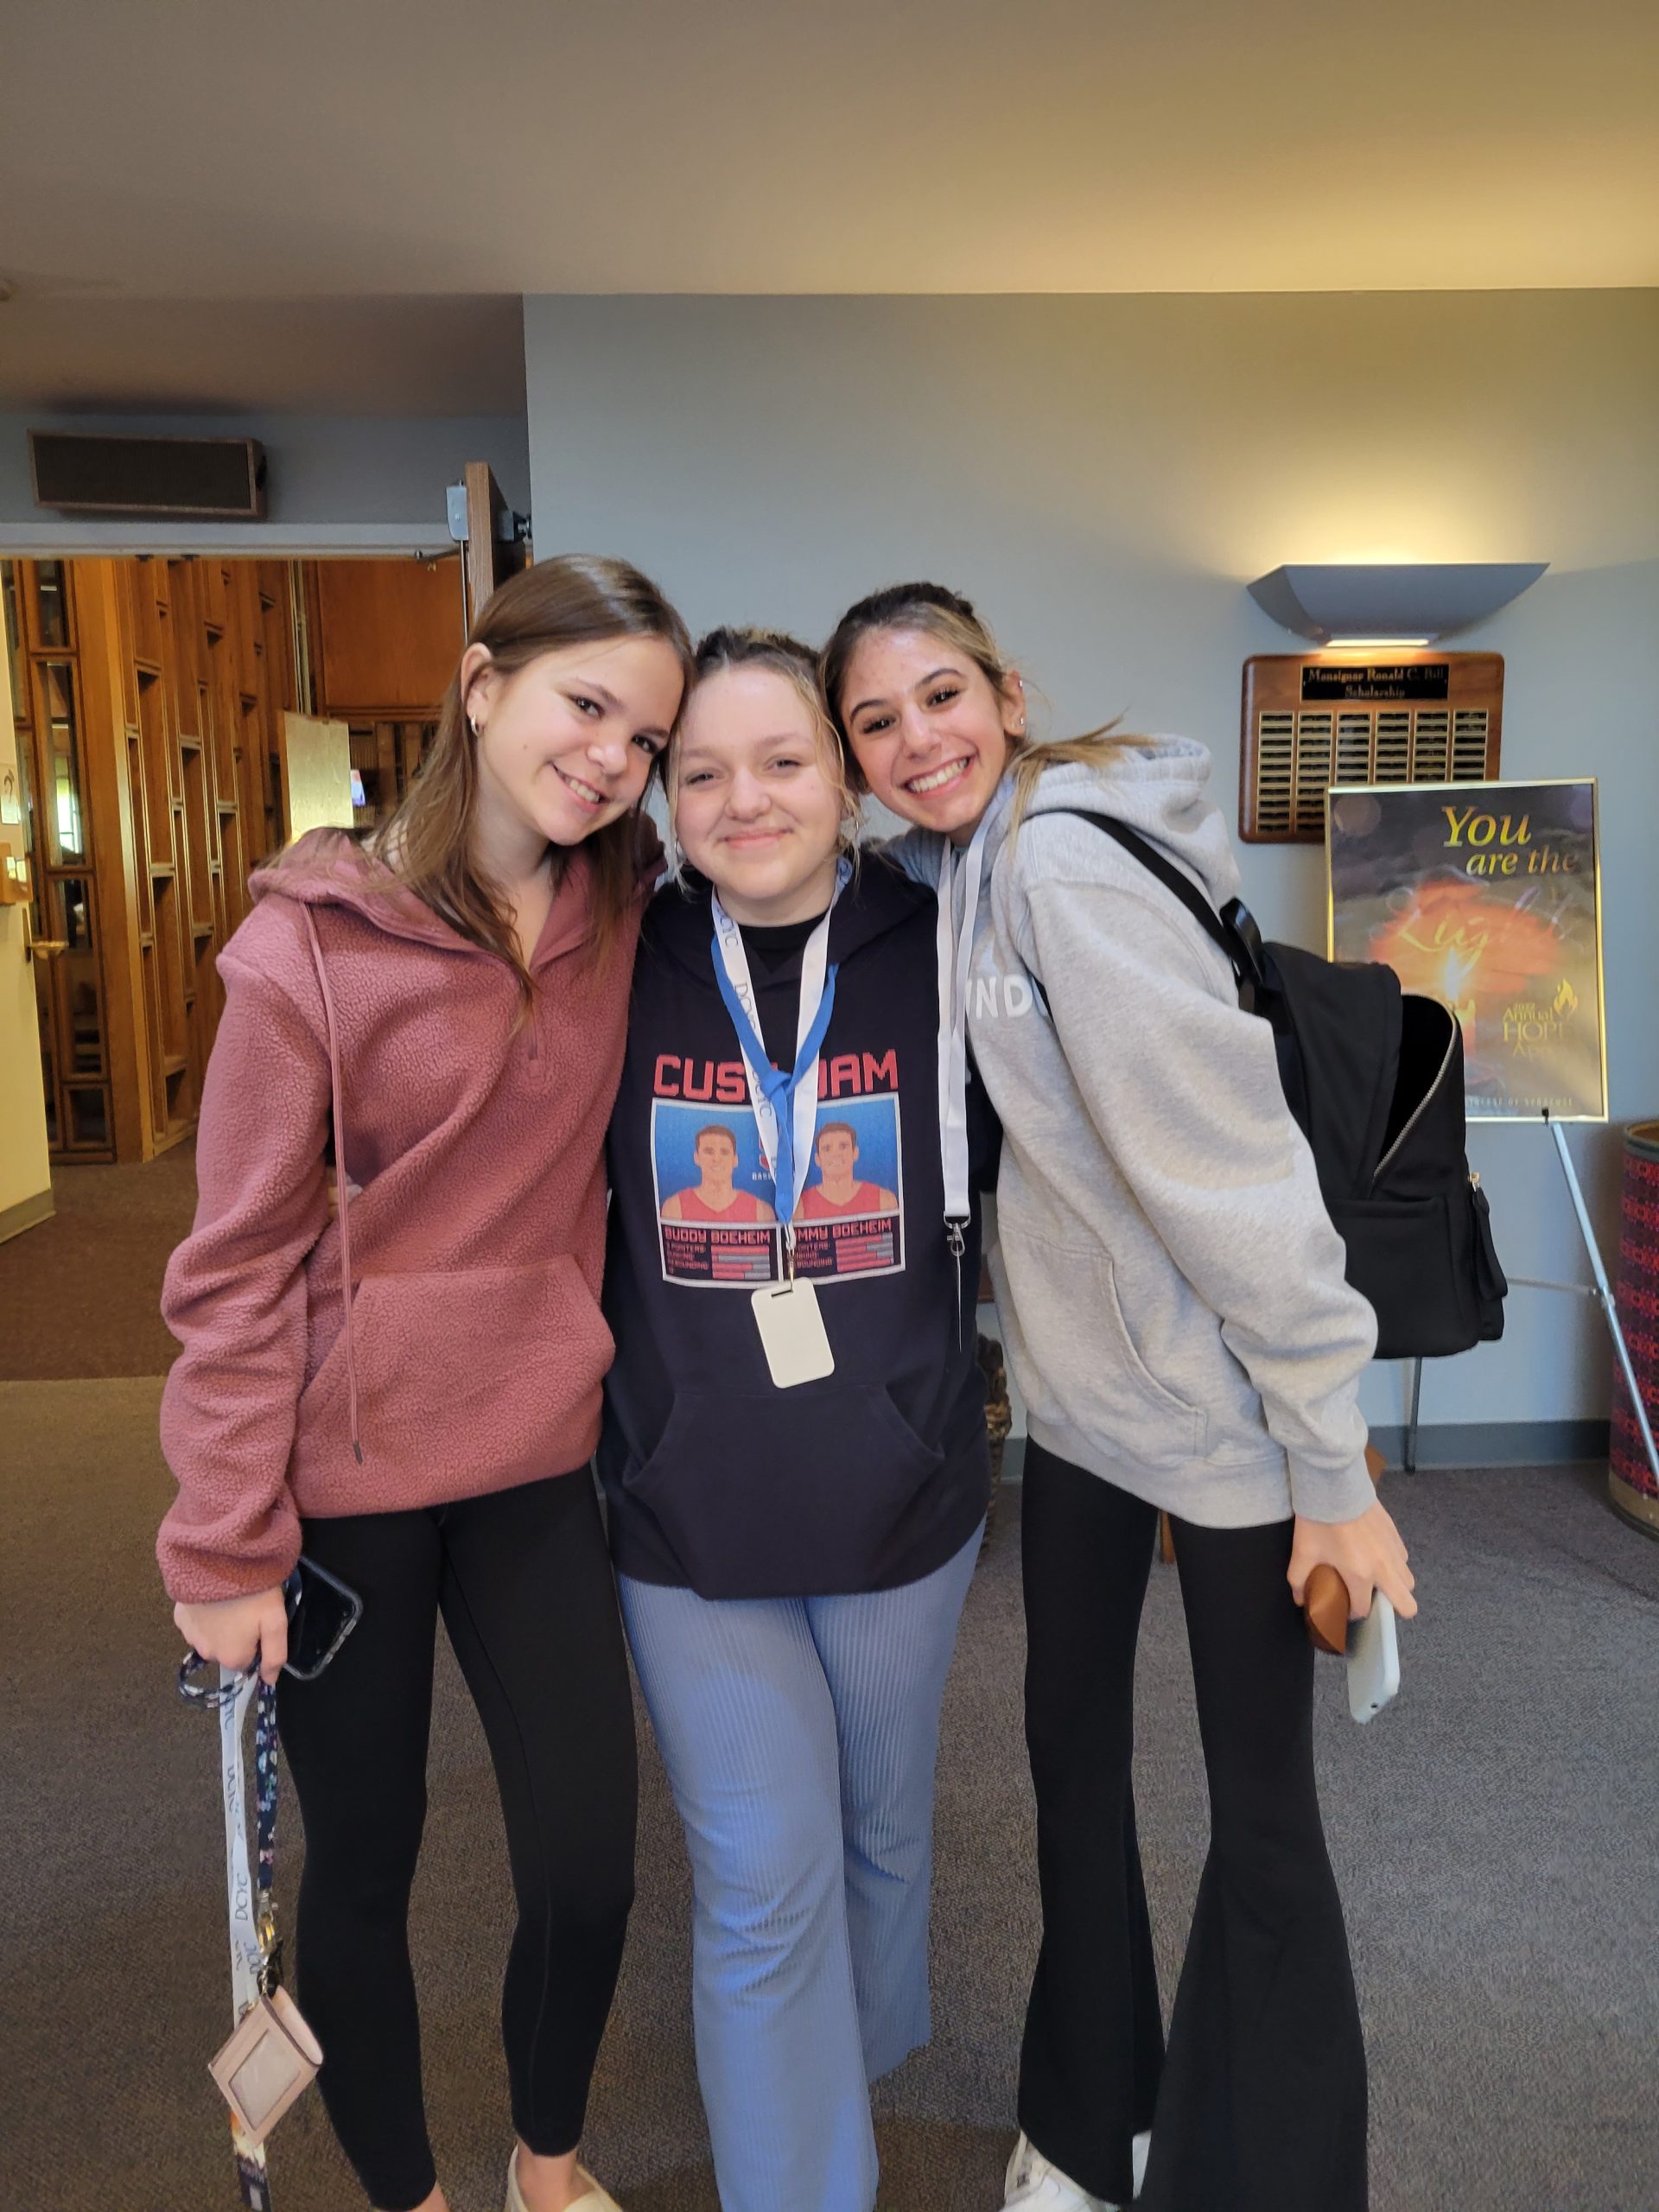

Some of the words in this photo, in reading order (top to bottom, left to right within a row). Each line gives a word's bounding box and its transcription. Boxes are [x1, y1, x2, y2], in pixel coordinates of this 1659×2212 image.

[1441, 805, 1532, 847] You
[1466, 852, 1519, 875] are
[1528, 844, 1579, 874] the
[1503, 1007, 1554, 1022] Annual
[654, 1054, 777, 1103] CUS
[794, 1225, 829, 1242] MMY
